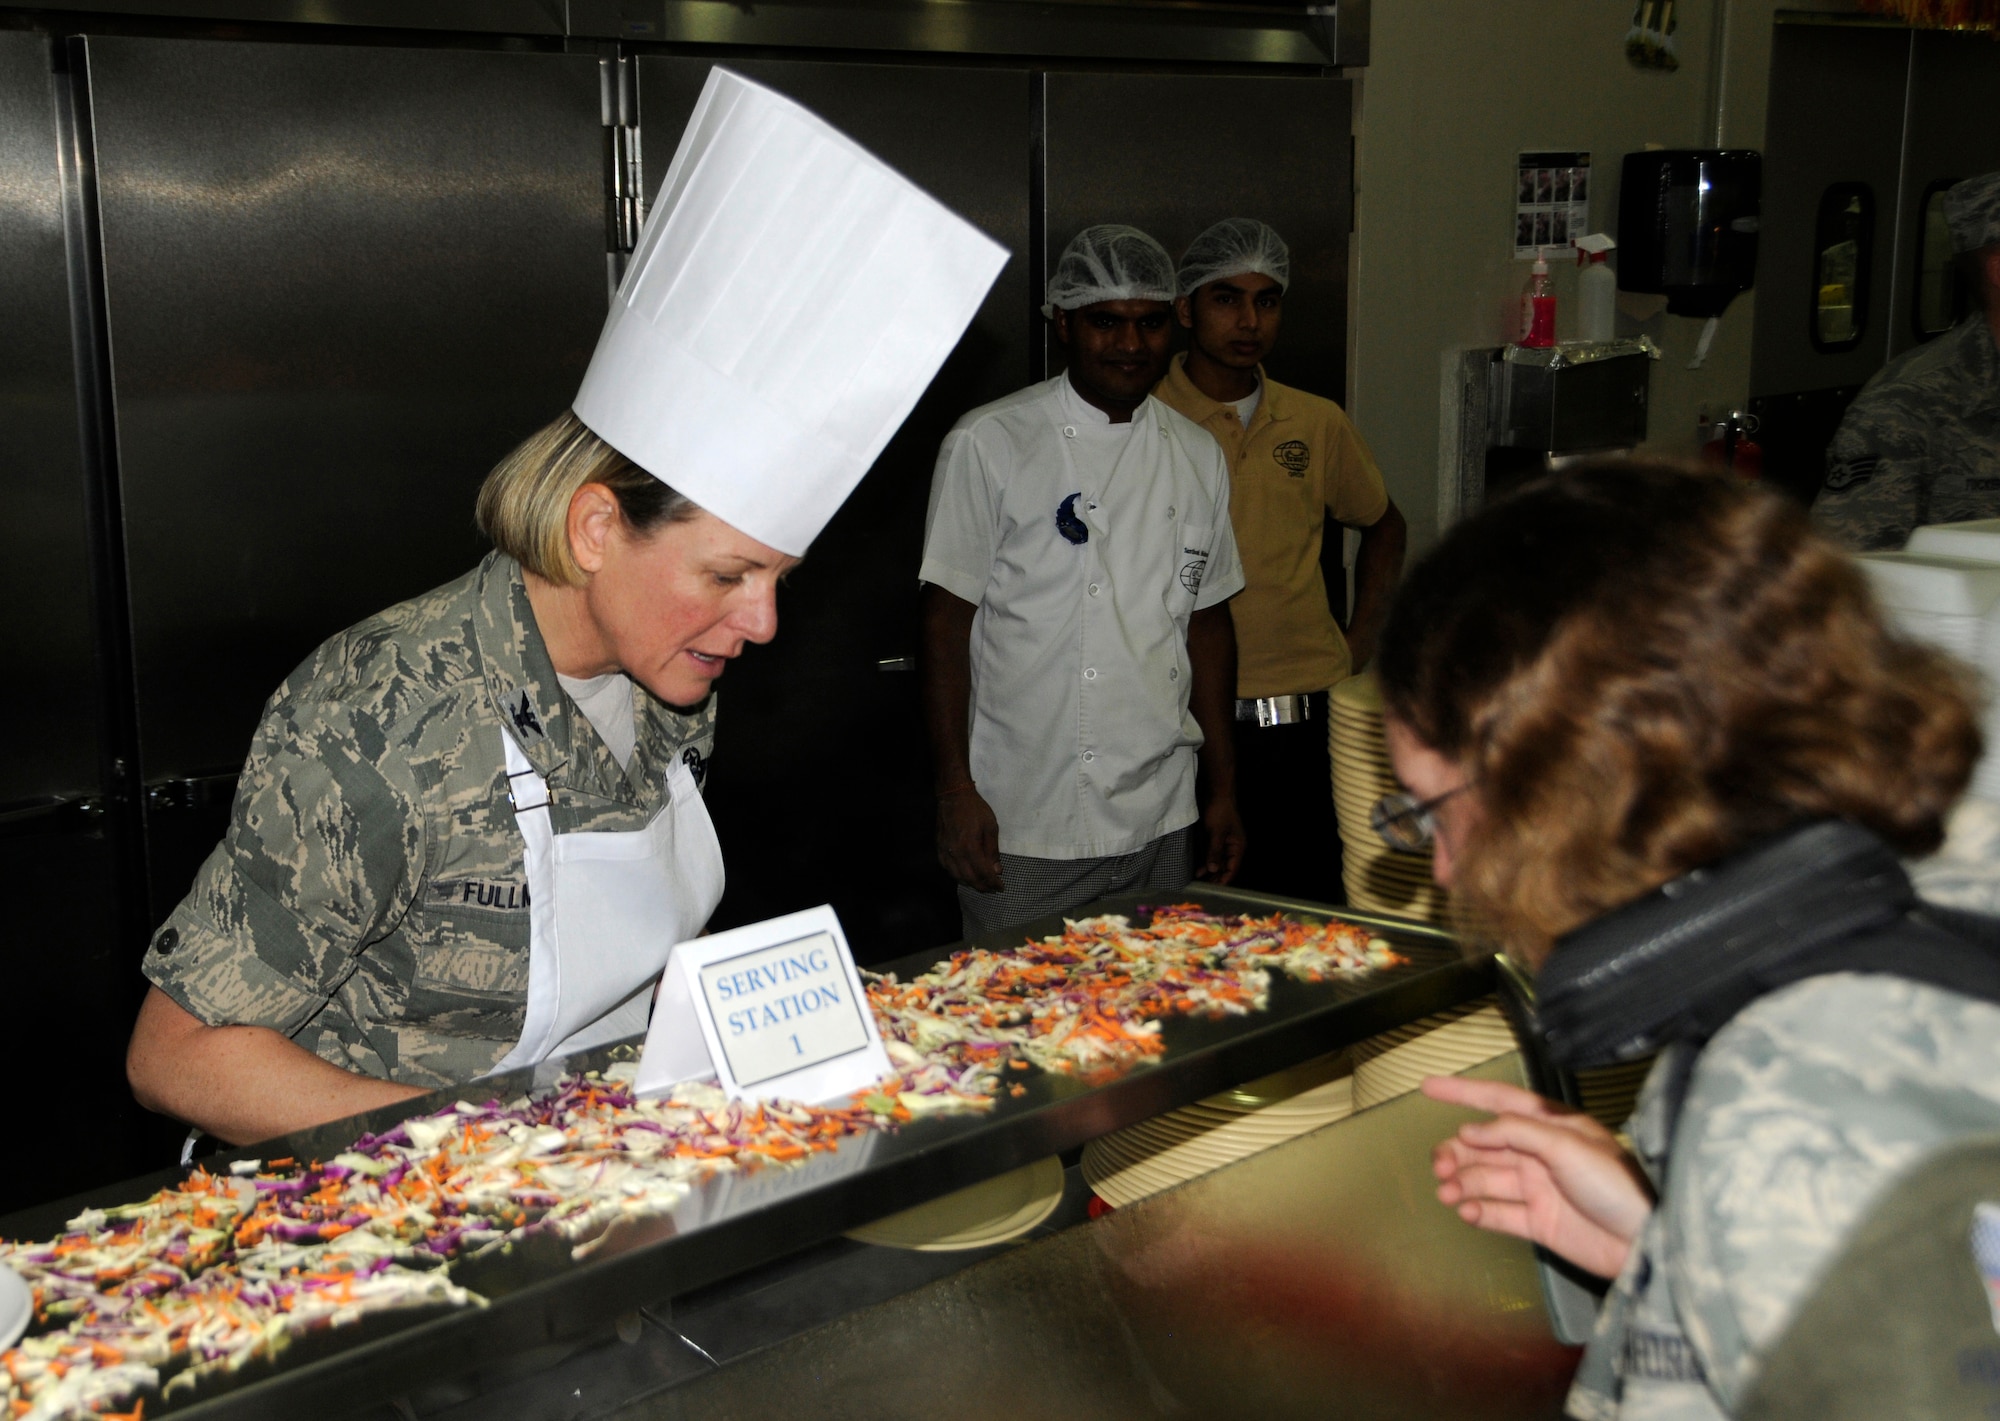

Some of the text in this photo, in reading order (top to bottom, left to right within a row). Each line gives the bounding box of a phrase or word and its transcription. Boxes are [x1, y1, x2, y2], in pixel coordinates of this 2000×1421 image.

[716, 948, 829, 1001] SERVING
[727, 983, 841, 1036] STATION
[788, 1034, 804, 1056] 1
